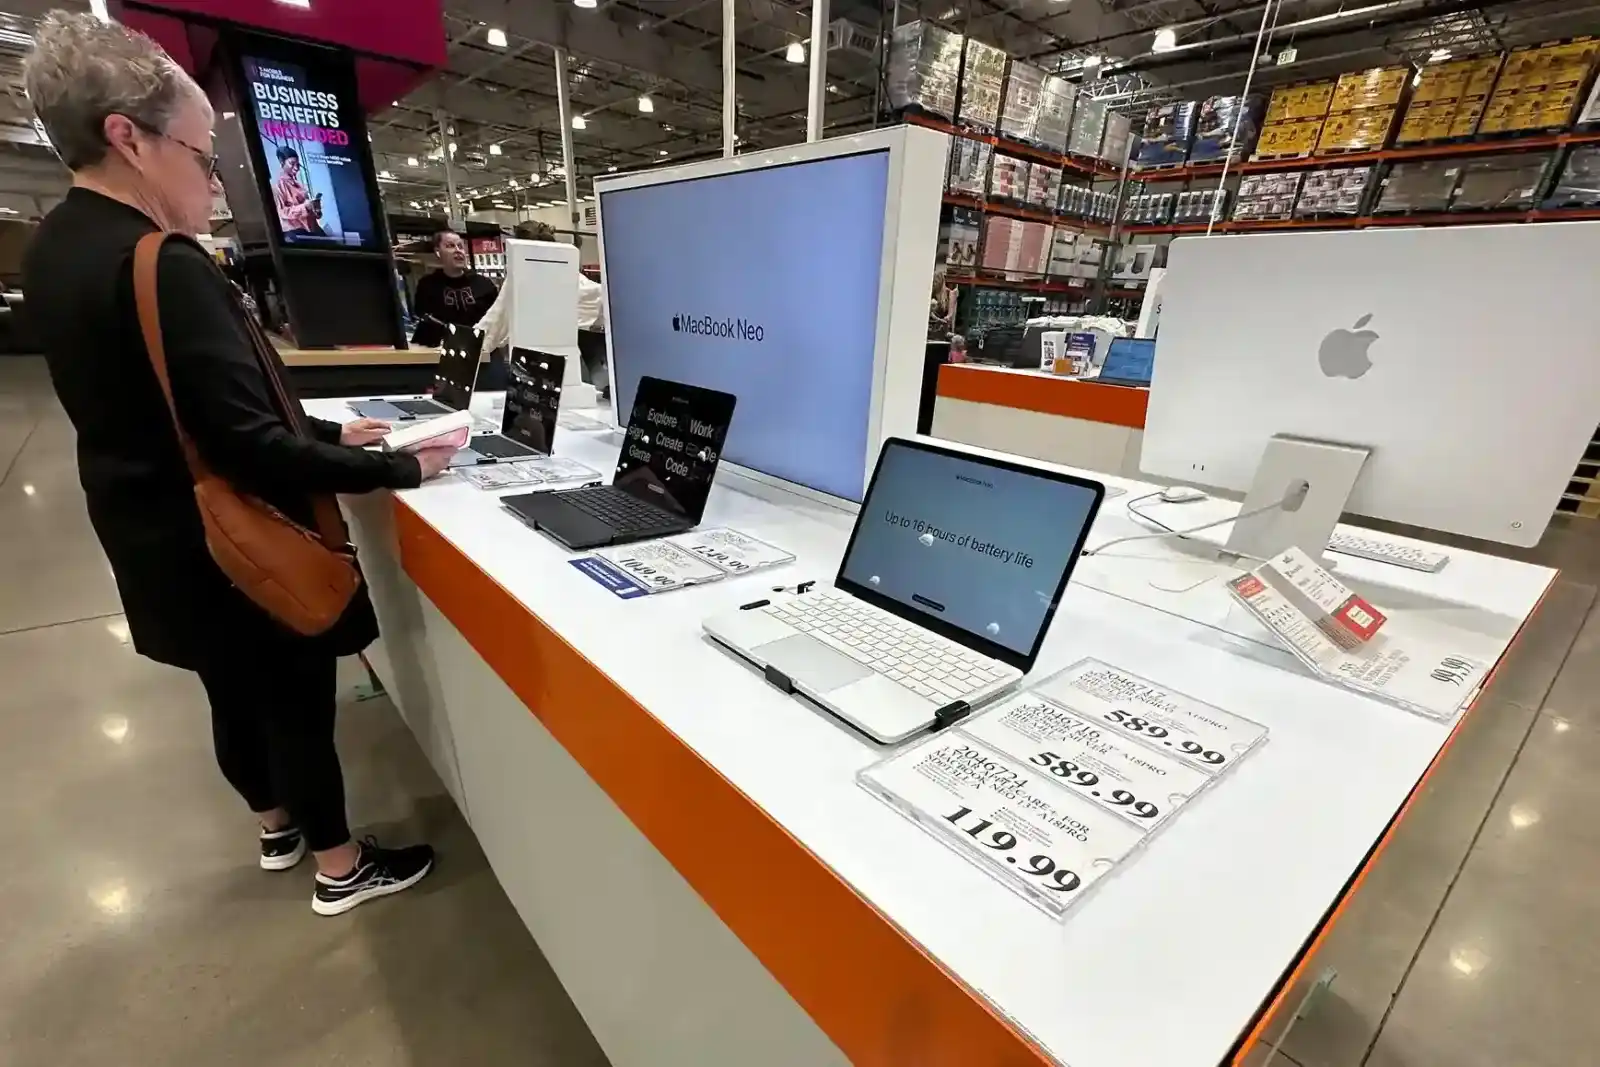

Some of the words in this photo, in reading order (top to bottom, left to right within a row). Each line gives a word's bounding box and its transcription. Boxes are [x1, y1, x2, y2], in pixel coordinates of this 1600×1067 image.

[253, 81, 339, 110] BUSINESS
[258, 101, 339, 128] BENEFITS
[263, 120, 349, 146] INCLUDED
[681, 313, 736, 338] MacBook
[737, 319, 764, 341] Neo
[648, 408, 677, 428] Explore
[690, 419, 714, 439] Work
[656, 432, 683, 452] Create
[629, 444, 651, 462] Game
[665, 457, 688, 476] Code
[885, 510, 899, 525] Up
[900, 516, 910, 528] to
[913, 519, 925, 532] 16
[925, 524, 956, 543] hours
[958, 535, 971, 546] of
[971, 538, 1013, 563] battery
[1015, 551, 1033, 568] life
[1035, 704, 1100, 738] 2046716
[1104, 710, 1225, 764] 589.99
[954, 746, 1028, 788] 2046724
[1124, 754, 1166, 775] A18PRO
[933, 750, 987, 784] MACBOOK
[988, 783, 1016, 800] NEO
[1038, 813, 1087, 841] A18PRO
[1029, 752, 1159, 822] 589.99
[1062, 816, 1089, 834] FOR
[941, 805, 1080, 892] 119.99
